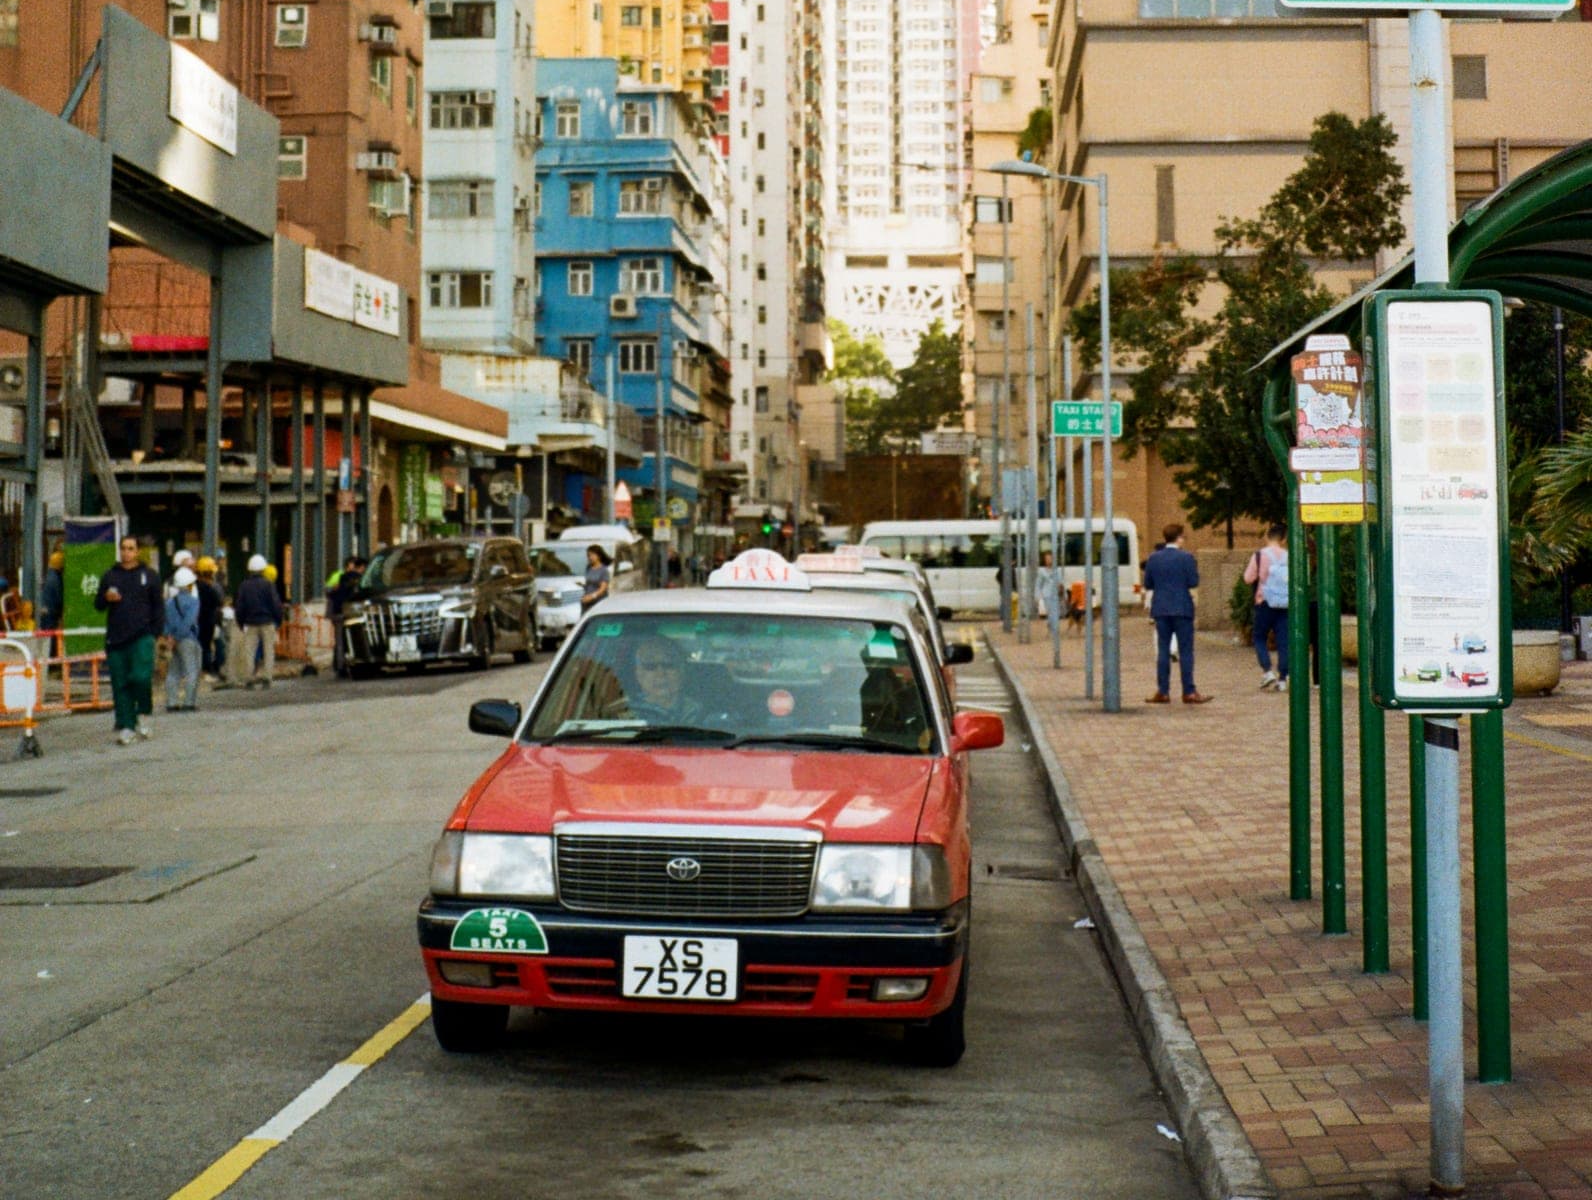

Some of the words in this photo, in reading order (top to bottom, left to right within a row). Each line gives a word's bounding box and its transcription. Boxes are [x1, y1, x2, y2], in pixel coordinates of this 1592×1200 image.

[1057, 406, 1080, 415] TAXI
[1082, 406, 1118, 416] STAD
[732, 566, 791, 582] TAXI
[488, 917, 509, 938] 5
[469, 938, 528, 950] SEATS
[659, 939, 704, 970] XS
[633, 967, 728, 997] 7578
